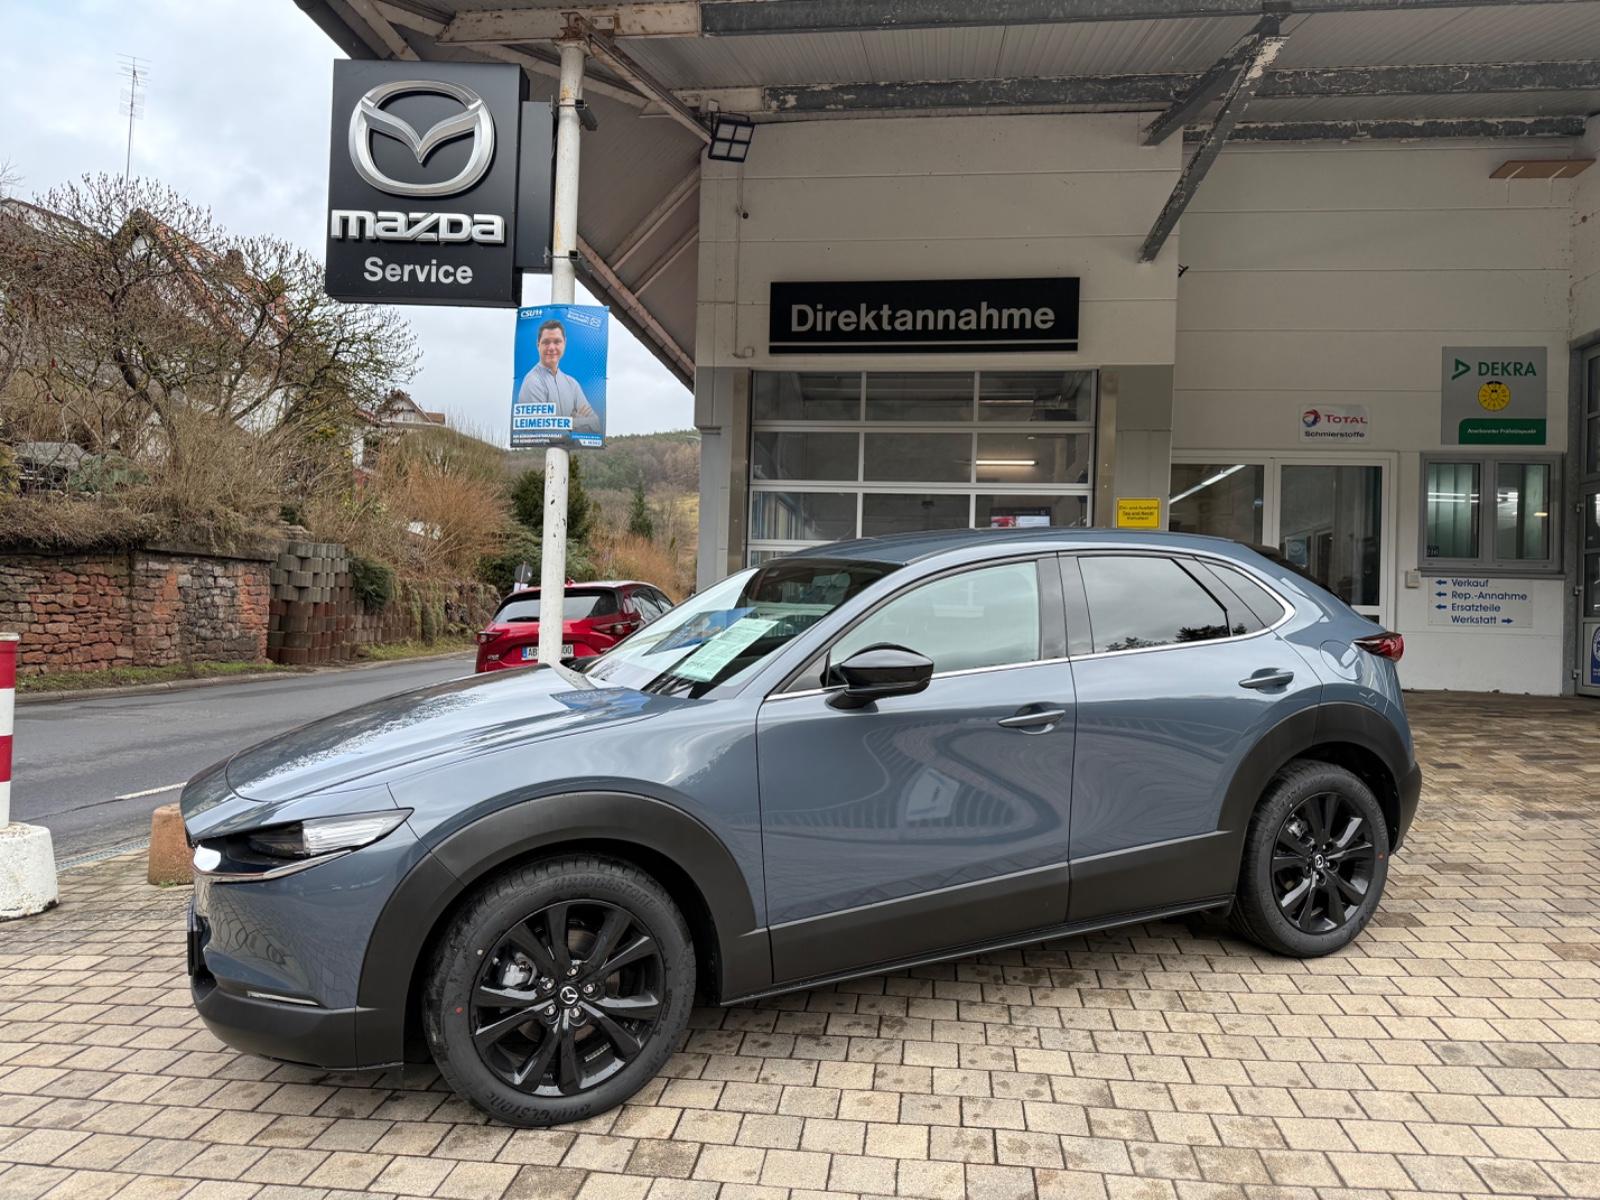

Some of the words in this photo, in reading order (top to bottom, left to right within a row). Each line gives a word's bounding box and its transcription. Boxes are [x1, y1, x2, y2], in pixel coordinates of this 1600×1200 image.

[330, 209, 505, 244] mazda
[363, 256, 474, 285] Service
[790, 301, 1056, 333] Direktannahme
[1477, 361, 1537, 377] DEKRA
[515, 404, 555, 416] STEFFEN
[514, 418, 571, 429] LEIMEISTER
[1324, 413, 1368, 425] TOTAL
[1304, 430, 1366, 439] Schmierstoffe
[1451, 578, 1489, 588] Verkauf
[1451, 591, 1528, 601] Rep.-Annahme
[1451, 603, 1502, 613] Ersatzteile
[1450, 615, 1497, 625] Werkstatt
[528, 648, 538, 657] AB
